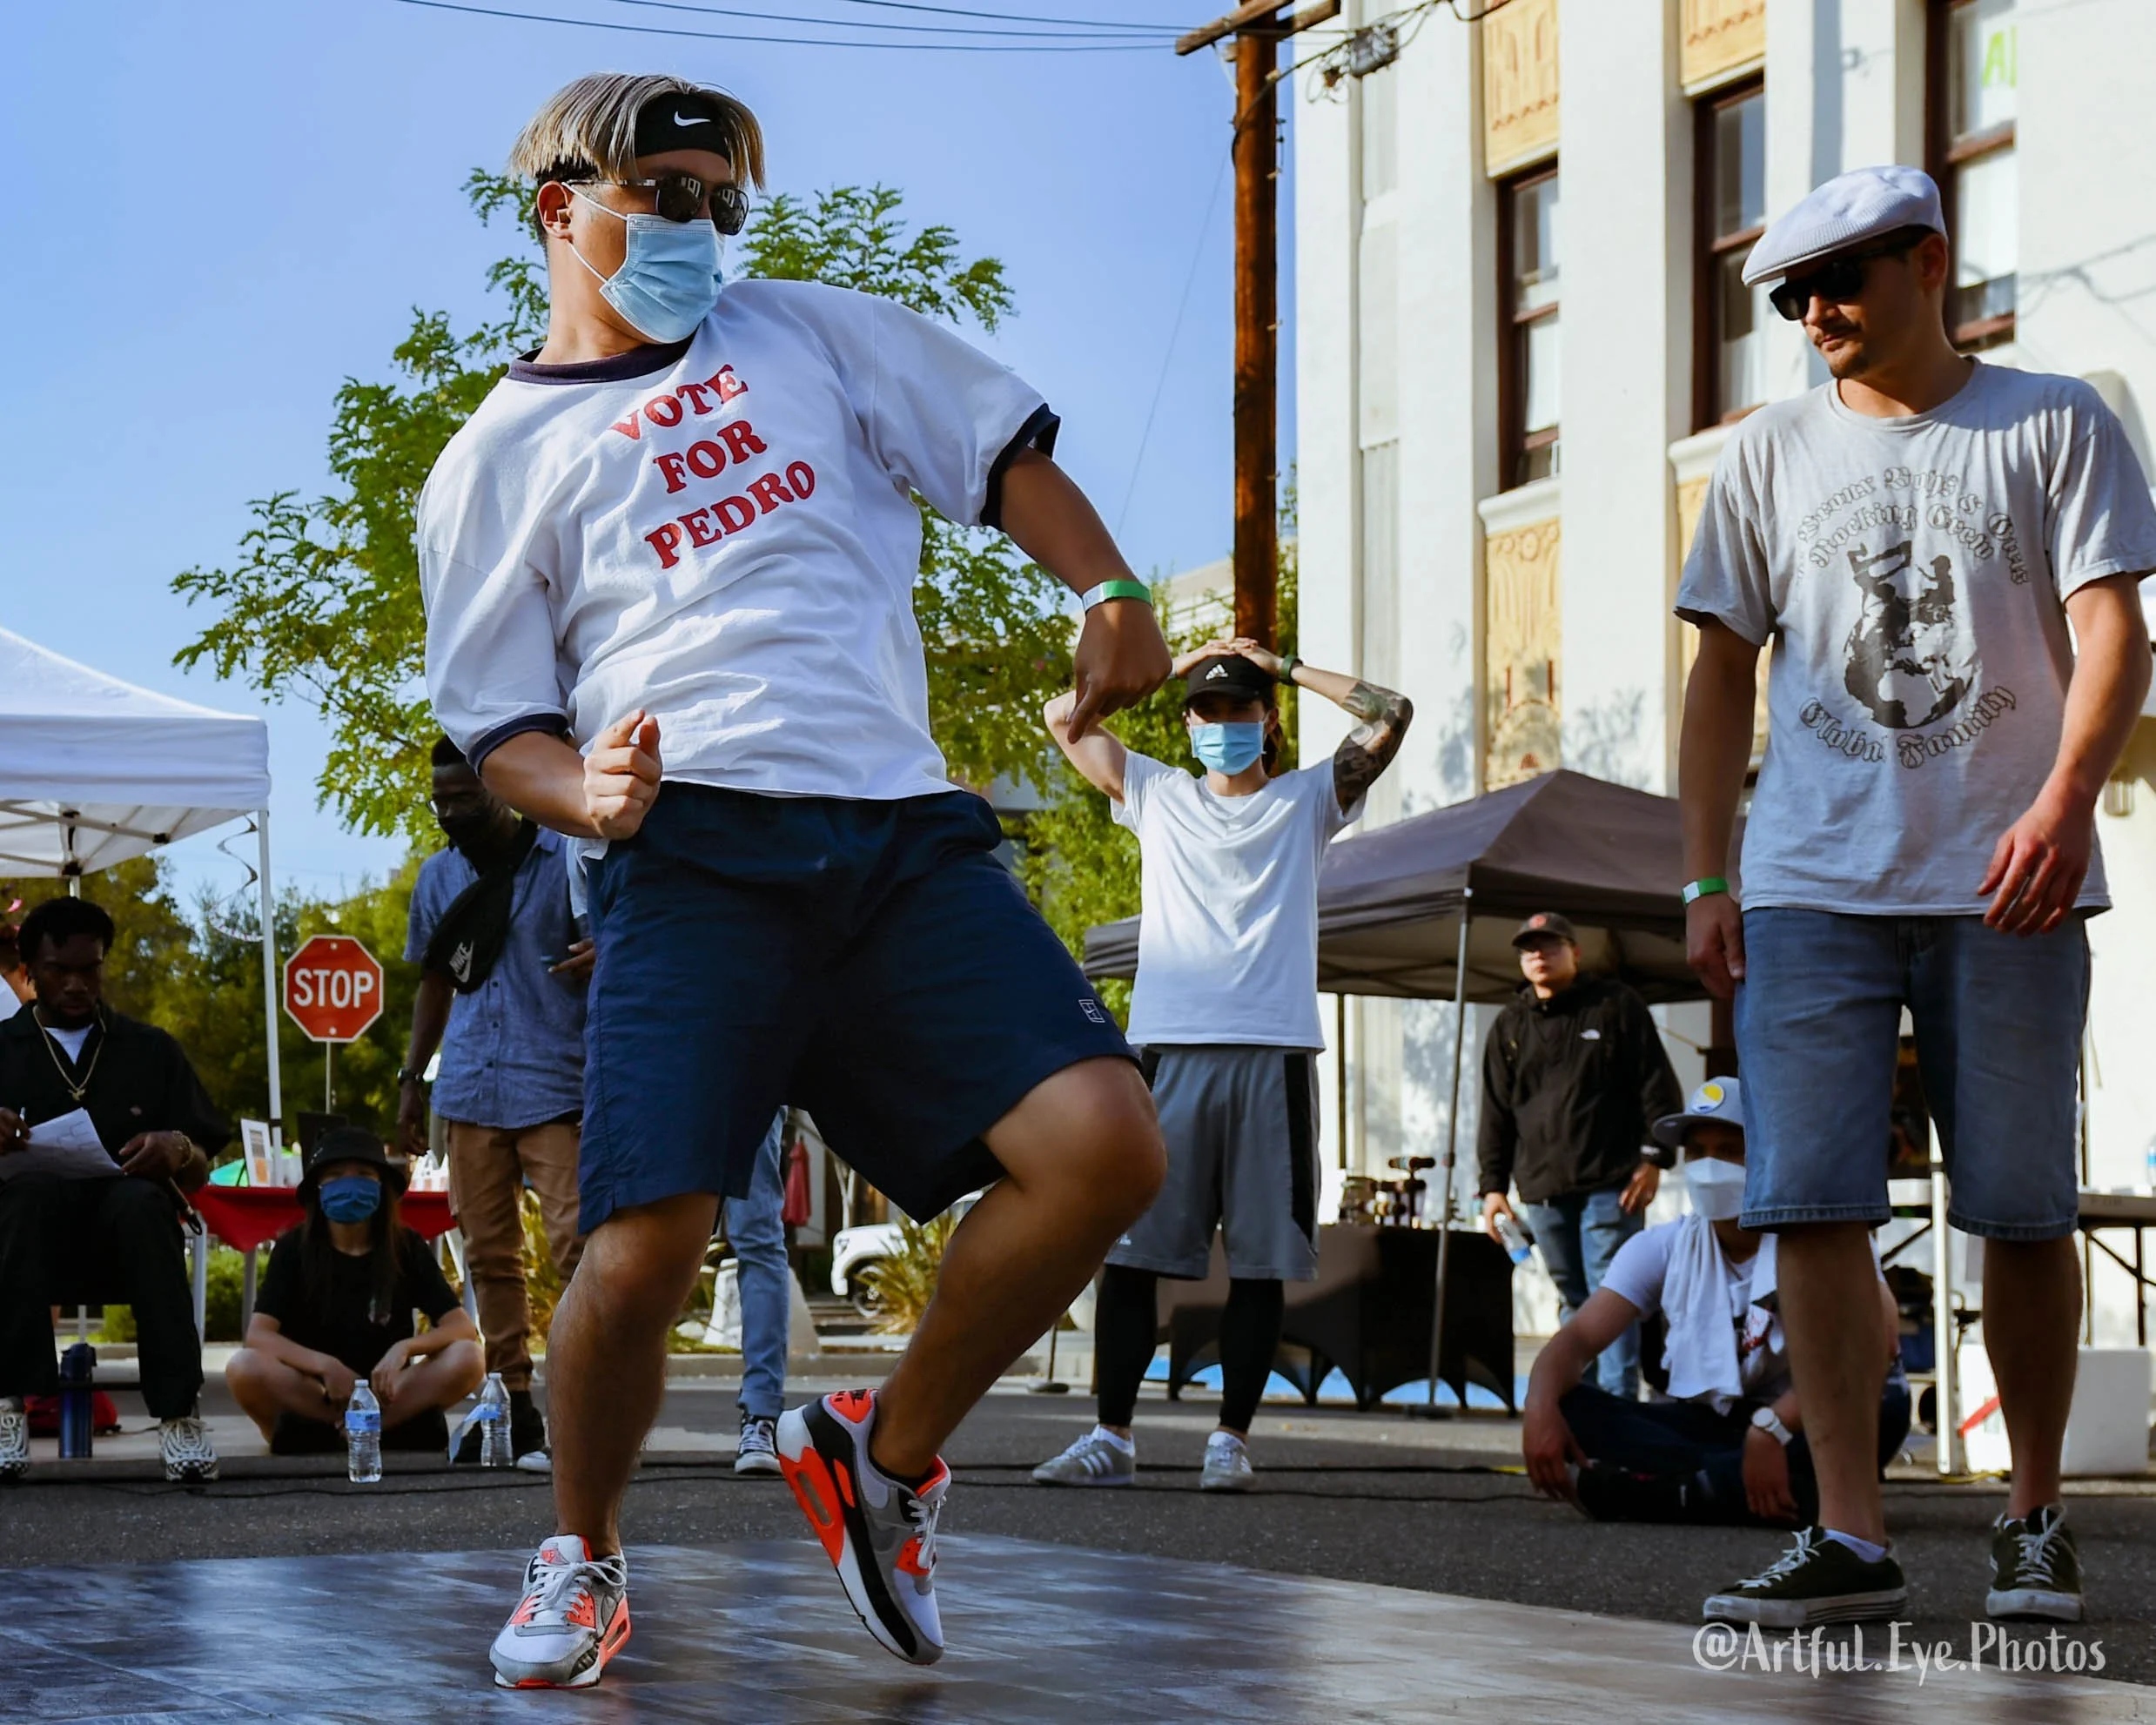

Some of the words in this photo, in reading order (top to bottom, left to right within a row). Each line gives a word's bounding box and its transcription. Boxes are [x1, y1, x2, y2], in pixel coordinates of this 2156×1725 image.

[609, 364, 749, 440] VOTE
[654, 420, 768, 493] FOR
[644, 460, 815, 569] PEDRO
[1810, 502, 1918, 567] Rocking
[1926, 503, 1994, 560] Crew
[1799, 697, 1887, 763] Globa
[1897, 686, 2017, 769] Family
[293, 968, 374, 1009] STOP
[449, 942, 467, 973] NIKE
